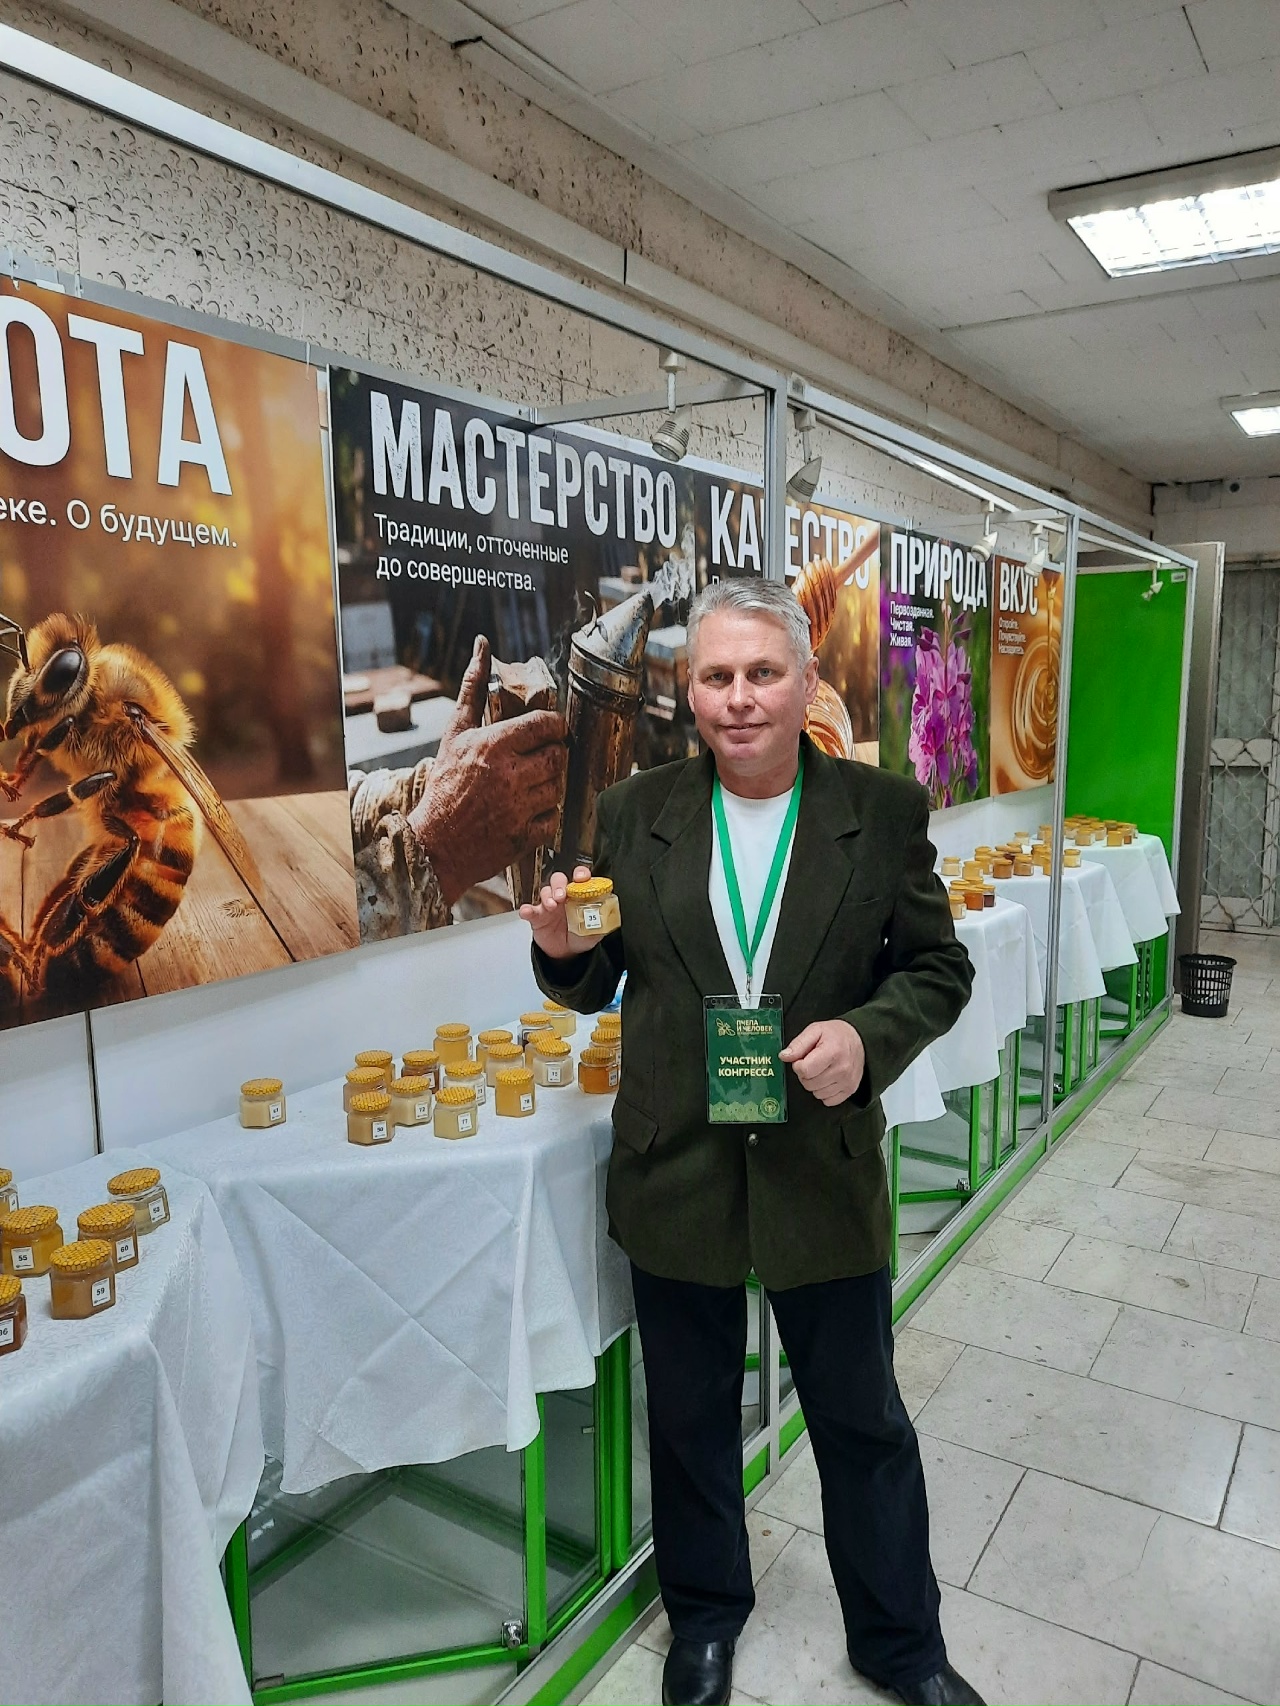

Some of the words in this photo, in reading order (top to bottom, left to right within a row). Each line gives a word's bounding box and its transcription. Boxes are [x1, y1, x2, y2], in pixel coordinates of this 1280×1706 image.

[370, 391, 677, 548] МАСТЕРСТВО
[66, 499, 91, 529] О
[100, 504, 238, 548] будущем.
[374, 513, 472, 554] Традиции,
[477, 534, 569, 564] отточенные
[710, 486, 870, 590] КАЕСТВО
[376, 556, 402, 580] до
[407, 560, 536, 591] совершенства.
[891, 532, 987, 613] ПРИРОДА
[1000, 562, 1038, 616] ВКУС
[890, 601, 934, 618] Первозданная.
[890, 617, 915, 632] Чистая.
[890, 632, 914, 647] Живая.
[719, 1056, 772, 1065] УЧАСТНИК
[718, 1068, 775, 1077] КОНГРЕССА
[120, 1245, 129, 1253] 60
[18, 1254, 28, 1262] 55
[96, 1287, 105, 1296] 59
